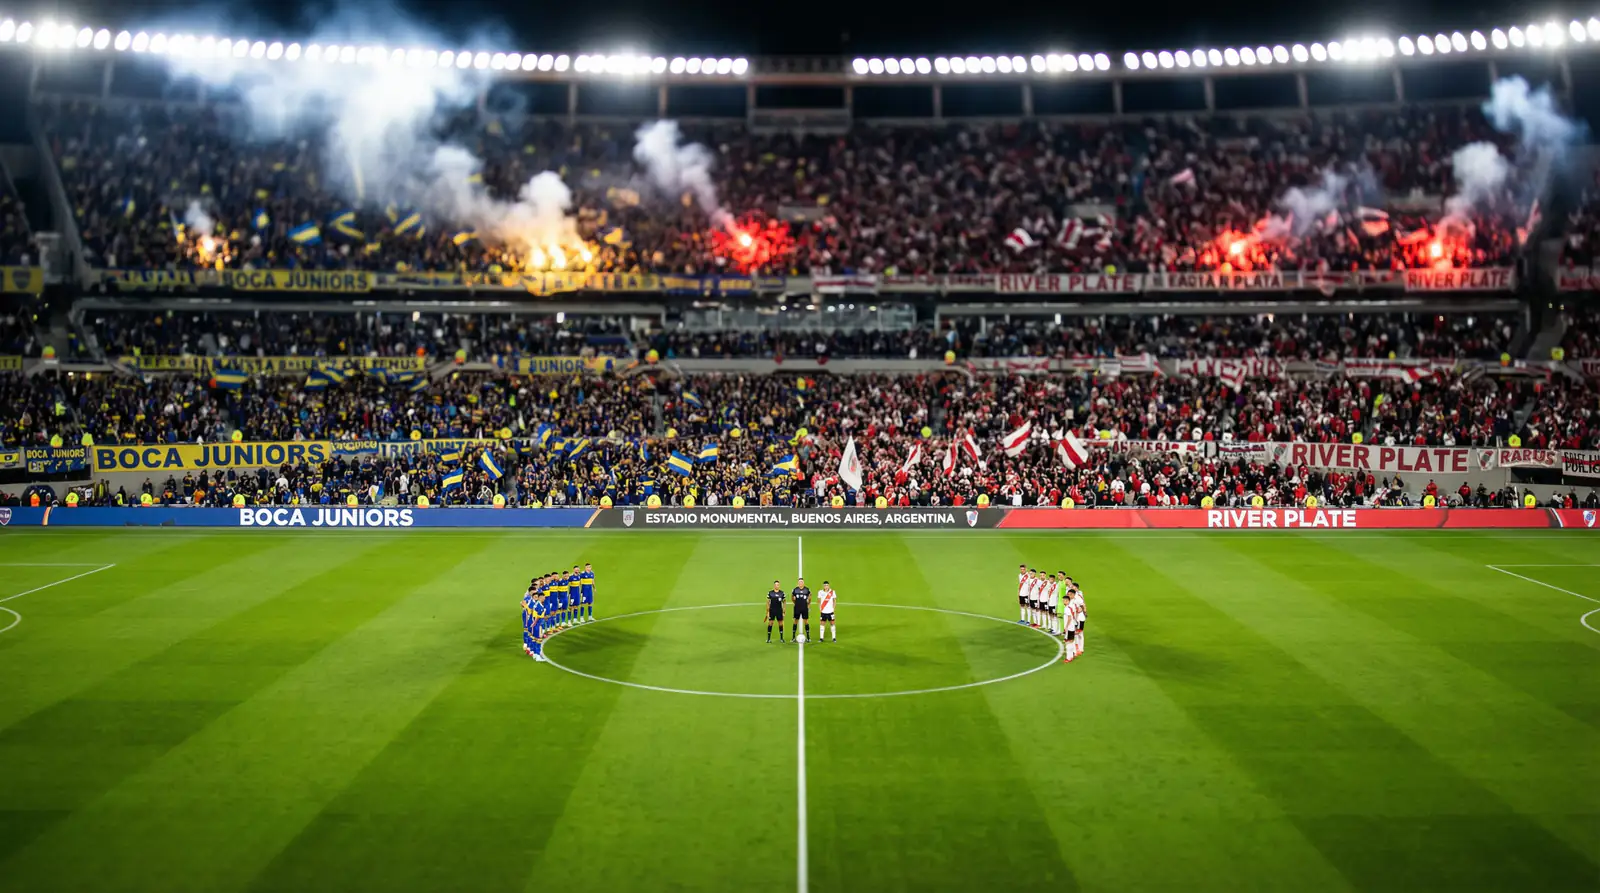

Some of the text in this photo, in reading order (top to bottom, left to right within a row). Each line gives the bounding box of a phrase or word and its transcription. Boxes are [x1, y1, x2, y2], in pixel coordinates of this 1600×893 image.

[284, 271, 369, 290] JUNIORS
[1000, 274, 1061, 292] RIVER
[1068, 274, 1135, 292] PLATE
[1407, 271, 1455, 289] RIVER
[1460, 269, 1512, 288] PLATE
[26, 448, 85, 459] BOCA JUNIORS
[97, 447, 184, 470] BOCA
[194, 443, 325, 467] JUNIORS
[1292, 443, 1371, 469] RIVER
[1379, 447, 1469, 472] PLATE
[239, 508, 414, 526] BOCA JUNIORS
[645, 513, 955, 526] ESTADIO MONUMENTAL, BUENOS AIRES, ARGENTINA
[1207, 509, 1357, 528] RIVER PLATE
